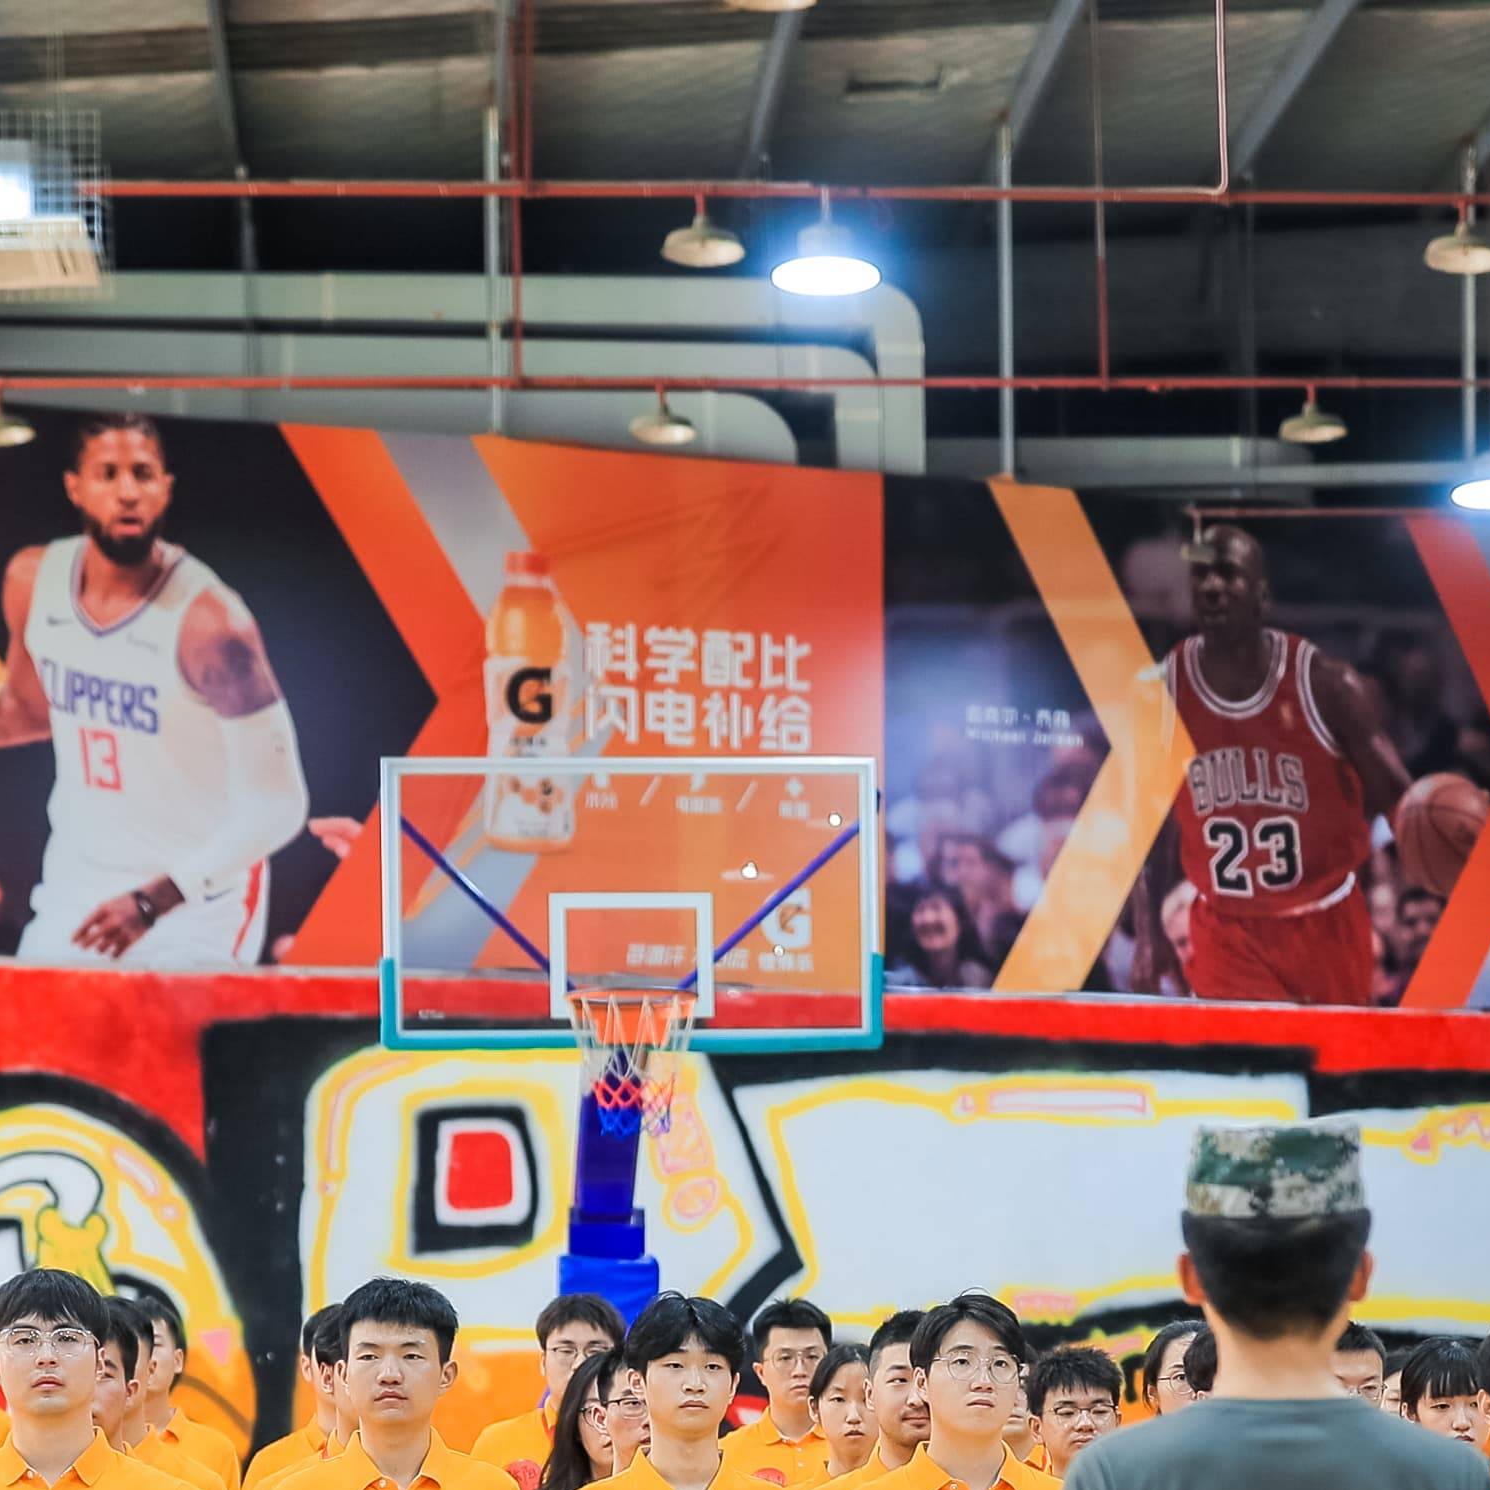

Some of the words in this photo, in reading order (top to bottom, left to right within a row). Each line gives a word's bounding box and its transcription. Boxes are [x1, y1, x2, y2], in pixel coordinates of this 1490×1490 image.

[585, 622, 812, 691] 科学配比
[41, 658, 159, 734] LIPPERS
[585, 686, 812, 753] 闪电补给
[78, 727, 125, 793] 13
[1187, 745, 1309, 816] BULLS
[1202, 815, 1303, 897] 23
